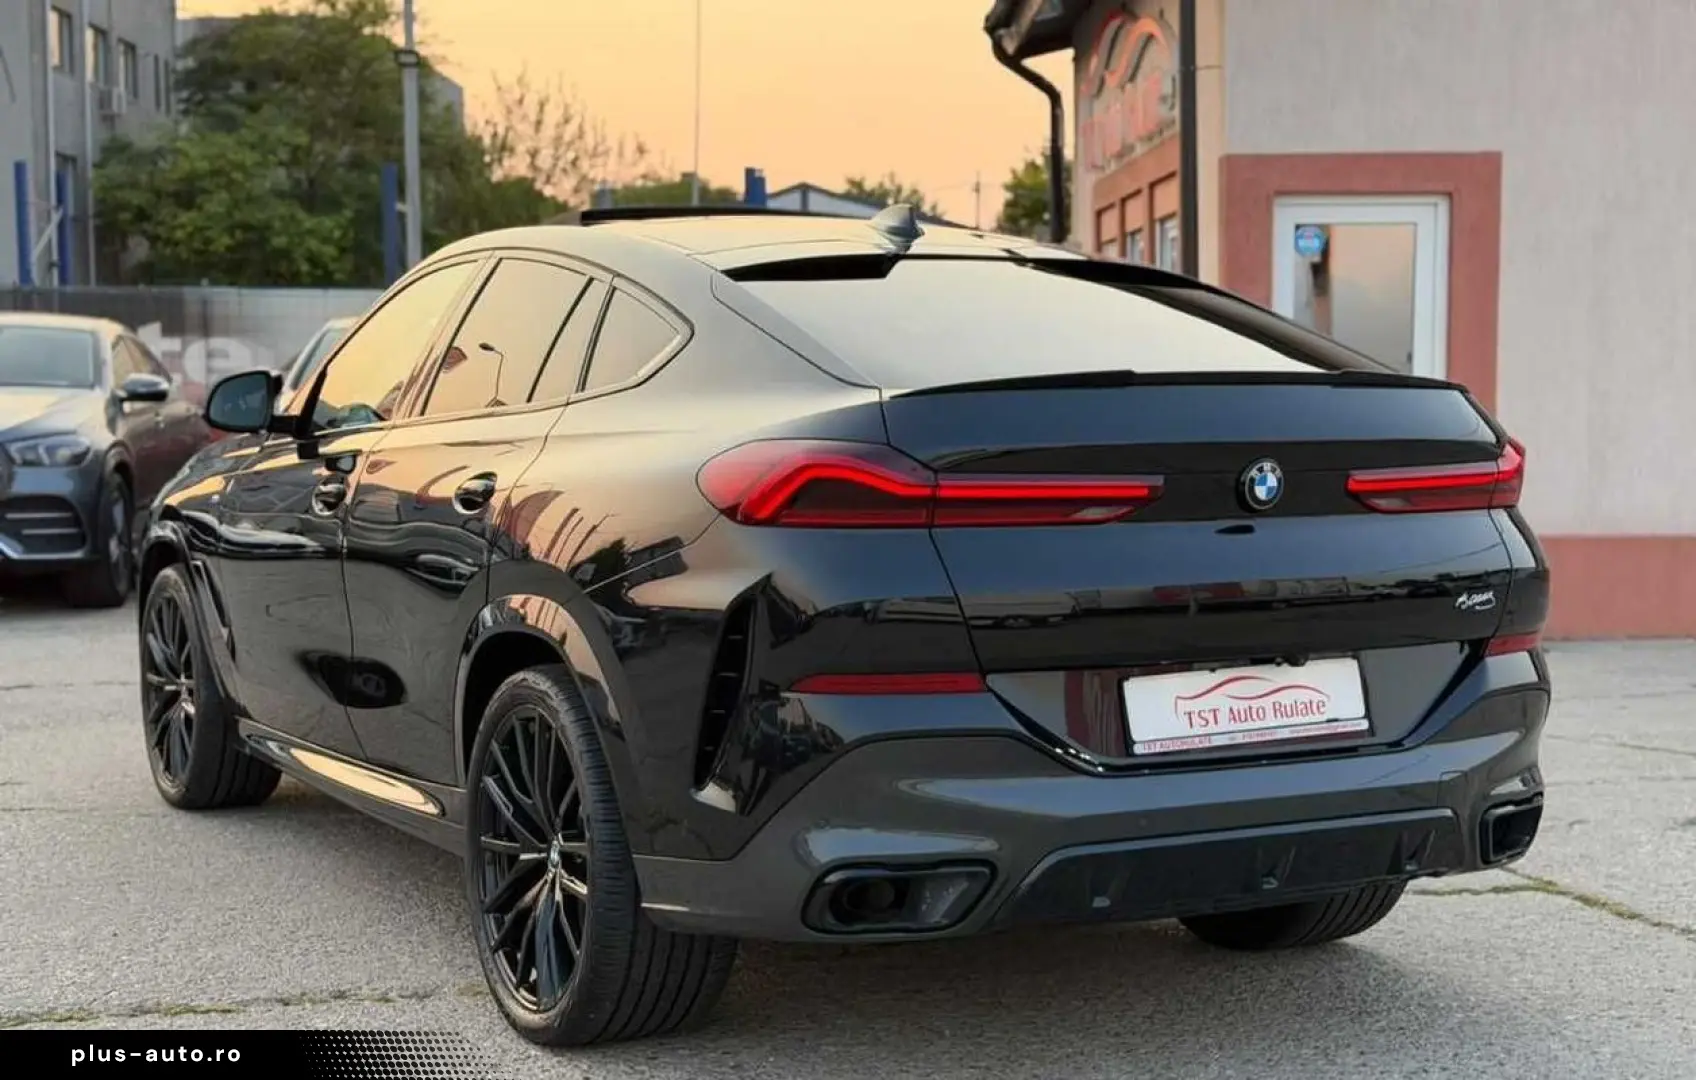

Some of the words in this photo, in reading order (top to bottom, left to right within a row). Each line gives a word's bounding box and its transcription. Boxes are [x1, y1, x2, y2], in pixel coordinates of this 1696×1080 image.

[1184, 708, 1220, 729] TST
[1227, 704, 1266, 724] Auto
[1272, 699, 1326, 720] Rulate
